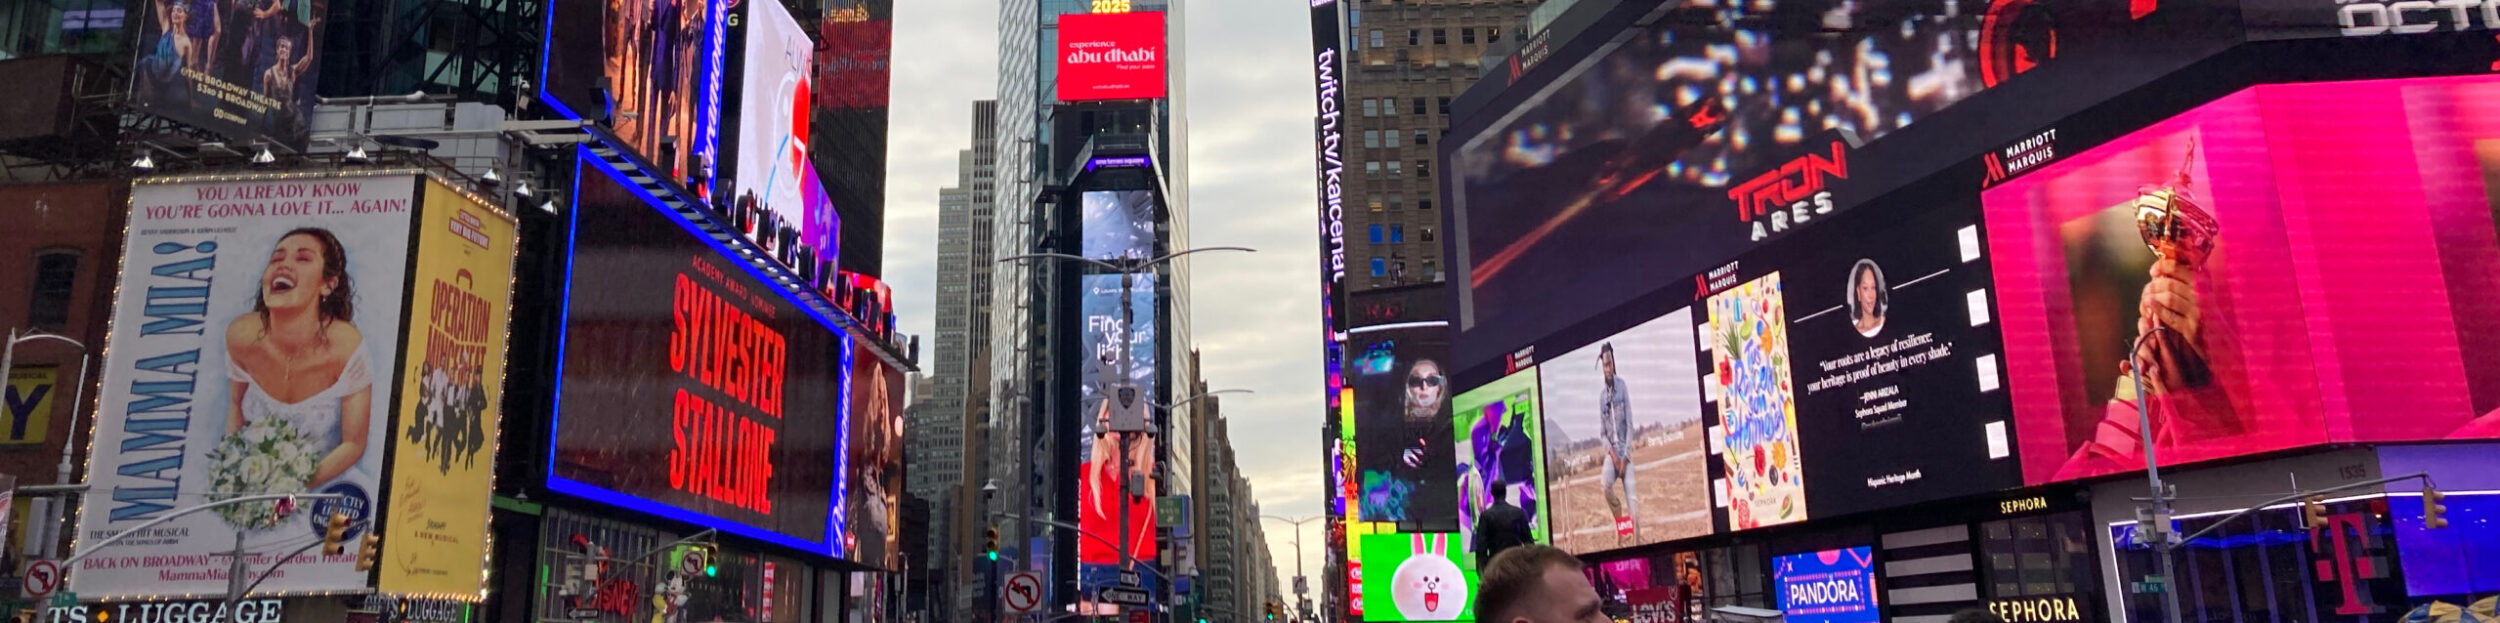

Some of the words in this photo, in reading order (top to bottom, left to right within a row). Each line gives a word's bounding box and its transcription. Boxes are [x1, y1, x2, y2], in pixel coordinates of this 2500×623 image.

[1092, 0, 1131, 13] 2025
[1067, 49, 1101, 64] abu
[1069, 41, 1116, 51] experience
[1521, 29, 1550, 58] MARRIOTT
[1522, 44, 1548, 72] MARQUIS
[204, 75, 249, 97] BROADWAY
[250, 90, 282, 110] THEATRE
[217, 89, 223, 99] &
[225, 92, 267, 114] BROADWAY
[2006, 128, 2056, 158] MARRIOTT
[1318, 47, 1344, 283] twitch.tv/kaicenat
[2008, 146, 2053, 173] MARQUIS
[196, 187, 228, 200] YOU
[236, 184, 307, 200] ALREADY
[312, 182, 362, 197] KNOW
[1728, 140, 1847, 222] TRON
[145, 204, 203, 219] YOU'RE
[208, 203, 266, 218] GONNA
[271, 201, 312, 216] LOVE
[317, 200, 345, 215] IT...
[350, 198, 408, 213] AGAIN!
[1751, 191, 1833, 241] ARES
[692, 254, 724, 284] ACADEMY
[725, 277, 747, 300] AWARD
[1708, 260, 1739, 279] MARRIOTT
[1709, 274, 1737, 291] MARQUIS
[140, 240, 218, 337] MIA!
[430, 278, 491, 345] OPERATION
[669, 272, 786, 420] SYLVESTER
[1837, 355, 1854, 368] roots
[1853, 351, 1865, 364] are
[1869, 346, 1890, 360] legacy
[1890, 338, 1899, 353] of
[1807, 381, 1821, 396] your
[1820, 375, 1846, 390] heritage
[1846, 371, 1853, 383] is
[1853, 364, 1870, 383] proof
[1870, 362, 1879, 376] of
[1878, 357, 1900, 374] beauty
[1900, 355, 1908, 368] in
[1908, 350, 1928, 365] every
[1873, 402, 1887, 414] Squad
[1887, 399, 1907, 410] Member
[109, 348, 201, 524] MAMMA
[669, 388, 776, 515] STALLONE
[1867, 477, 1886, 488] Hispanic
[1886, 474, 1906, 484] Heritage
[1906, 468, 1922, 481] Month
[2338, 464, 2366, 480] 1535
[2000, 496, 2048, 514] SEPHORA
[90, 528, 104, 540] THE
[153, 527, 190, 537] MUSICAL
[83, 556, 117, 570] BACK
[120, 555, 139, 569] ON
[142, 553, 211, 568] BROADWAY
[2310, 513, 2376, 615] T
[1126, 592, 1143, 601] WAY
[1790, 579, 1859, 606] PANDORA
[118, 599, 282, 623] LUGGAGE
[406, 598, 459, 621] LUGGAGE
[1989, 597, 2080, 623] SEPHORA
